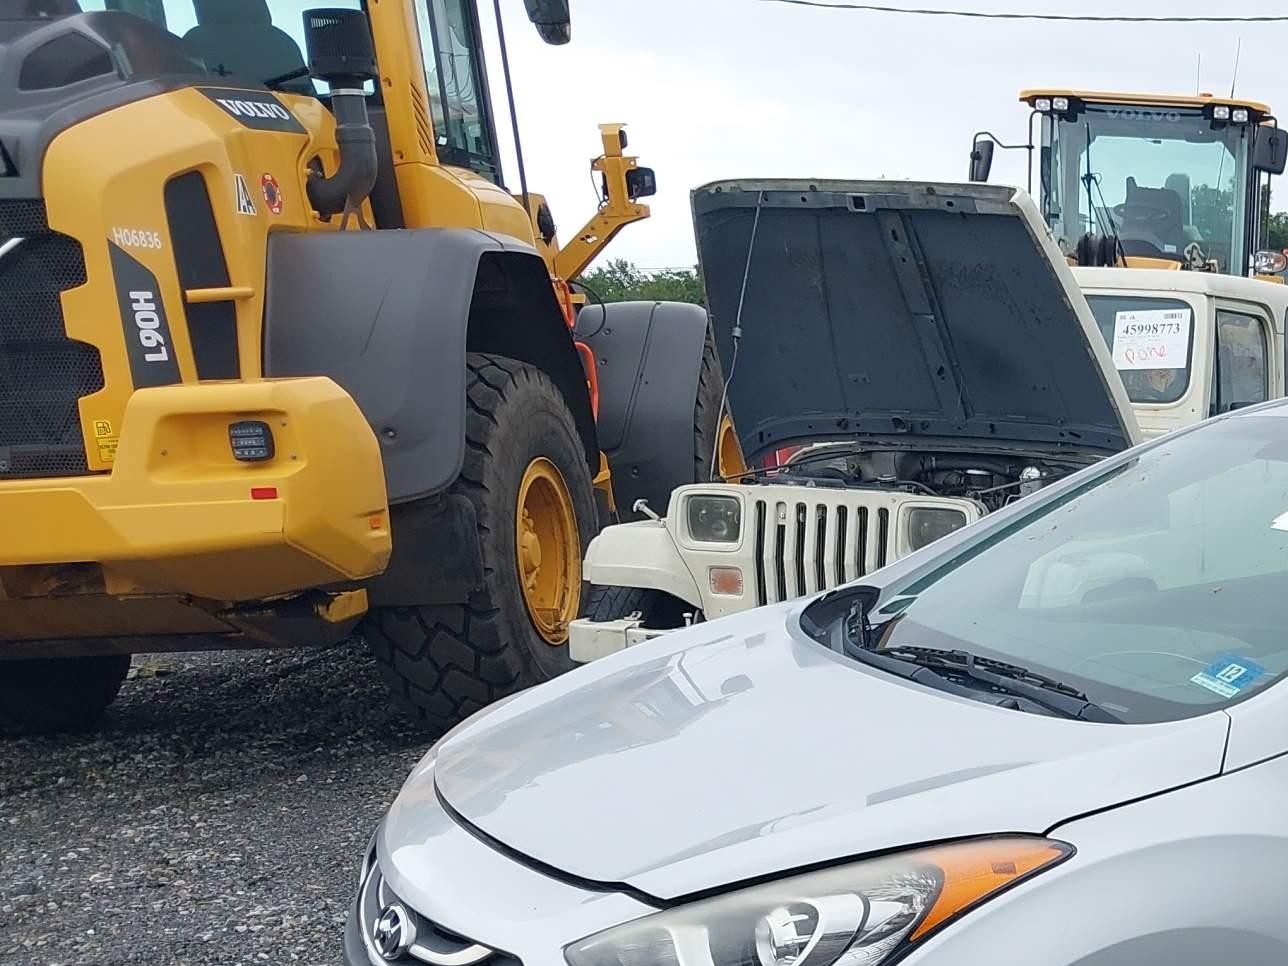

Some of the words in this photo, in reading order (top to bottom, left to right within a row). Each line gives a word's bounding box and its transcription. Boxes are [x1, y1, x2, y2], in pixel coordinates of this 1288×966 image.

[215, 98, 290, 120] VOLVO
[1105, 108, 1181, 122] VOLVO
[112, 227, 162, 249] H06836
[129, 291, 168, 362] L90H
[1122, 322, 1181, 336] 45998773
